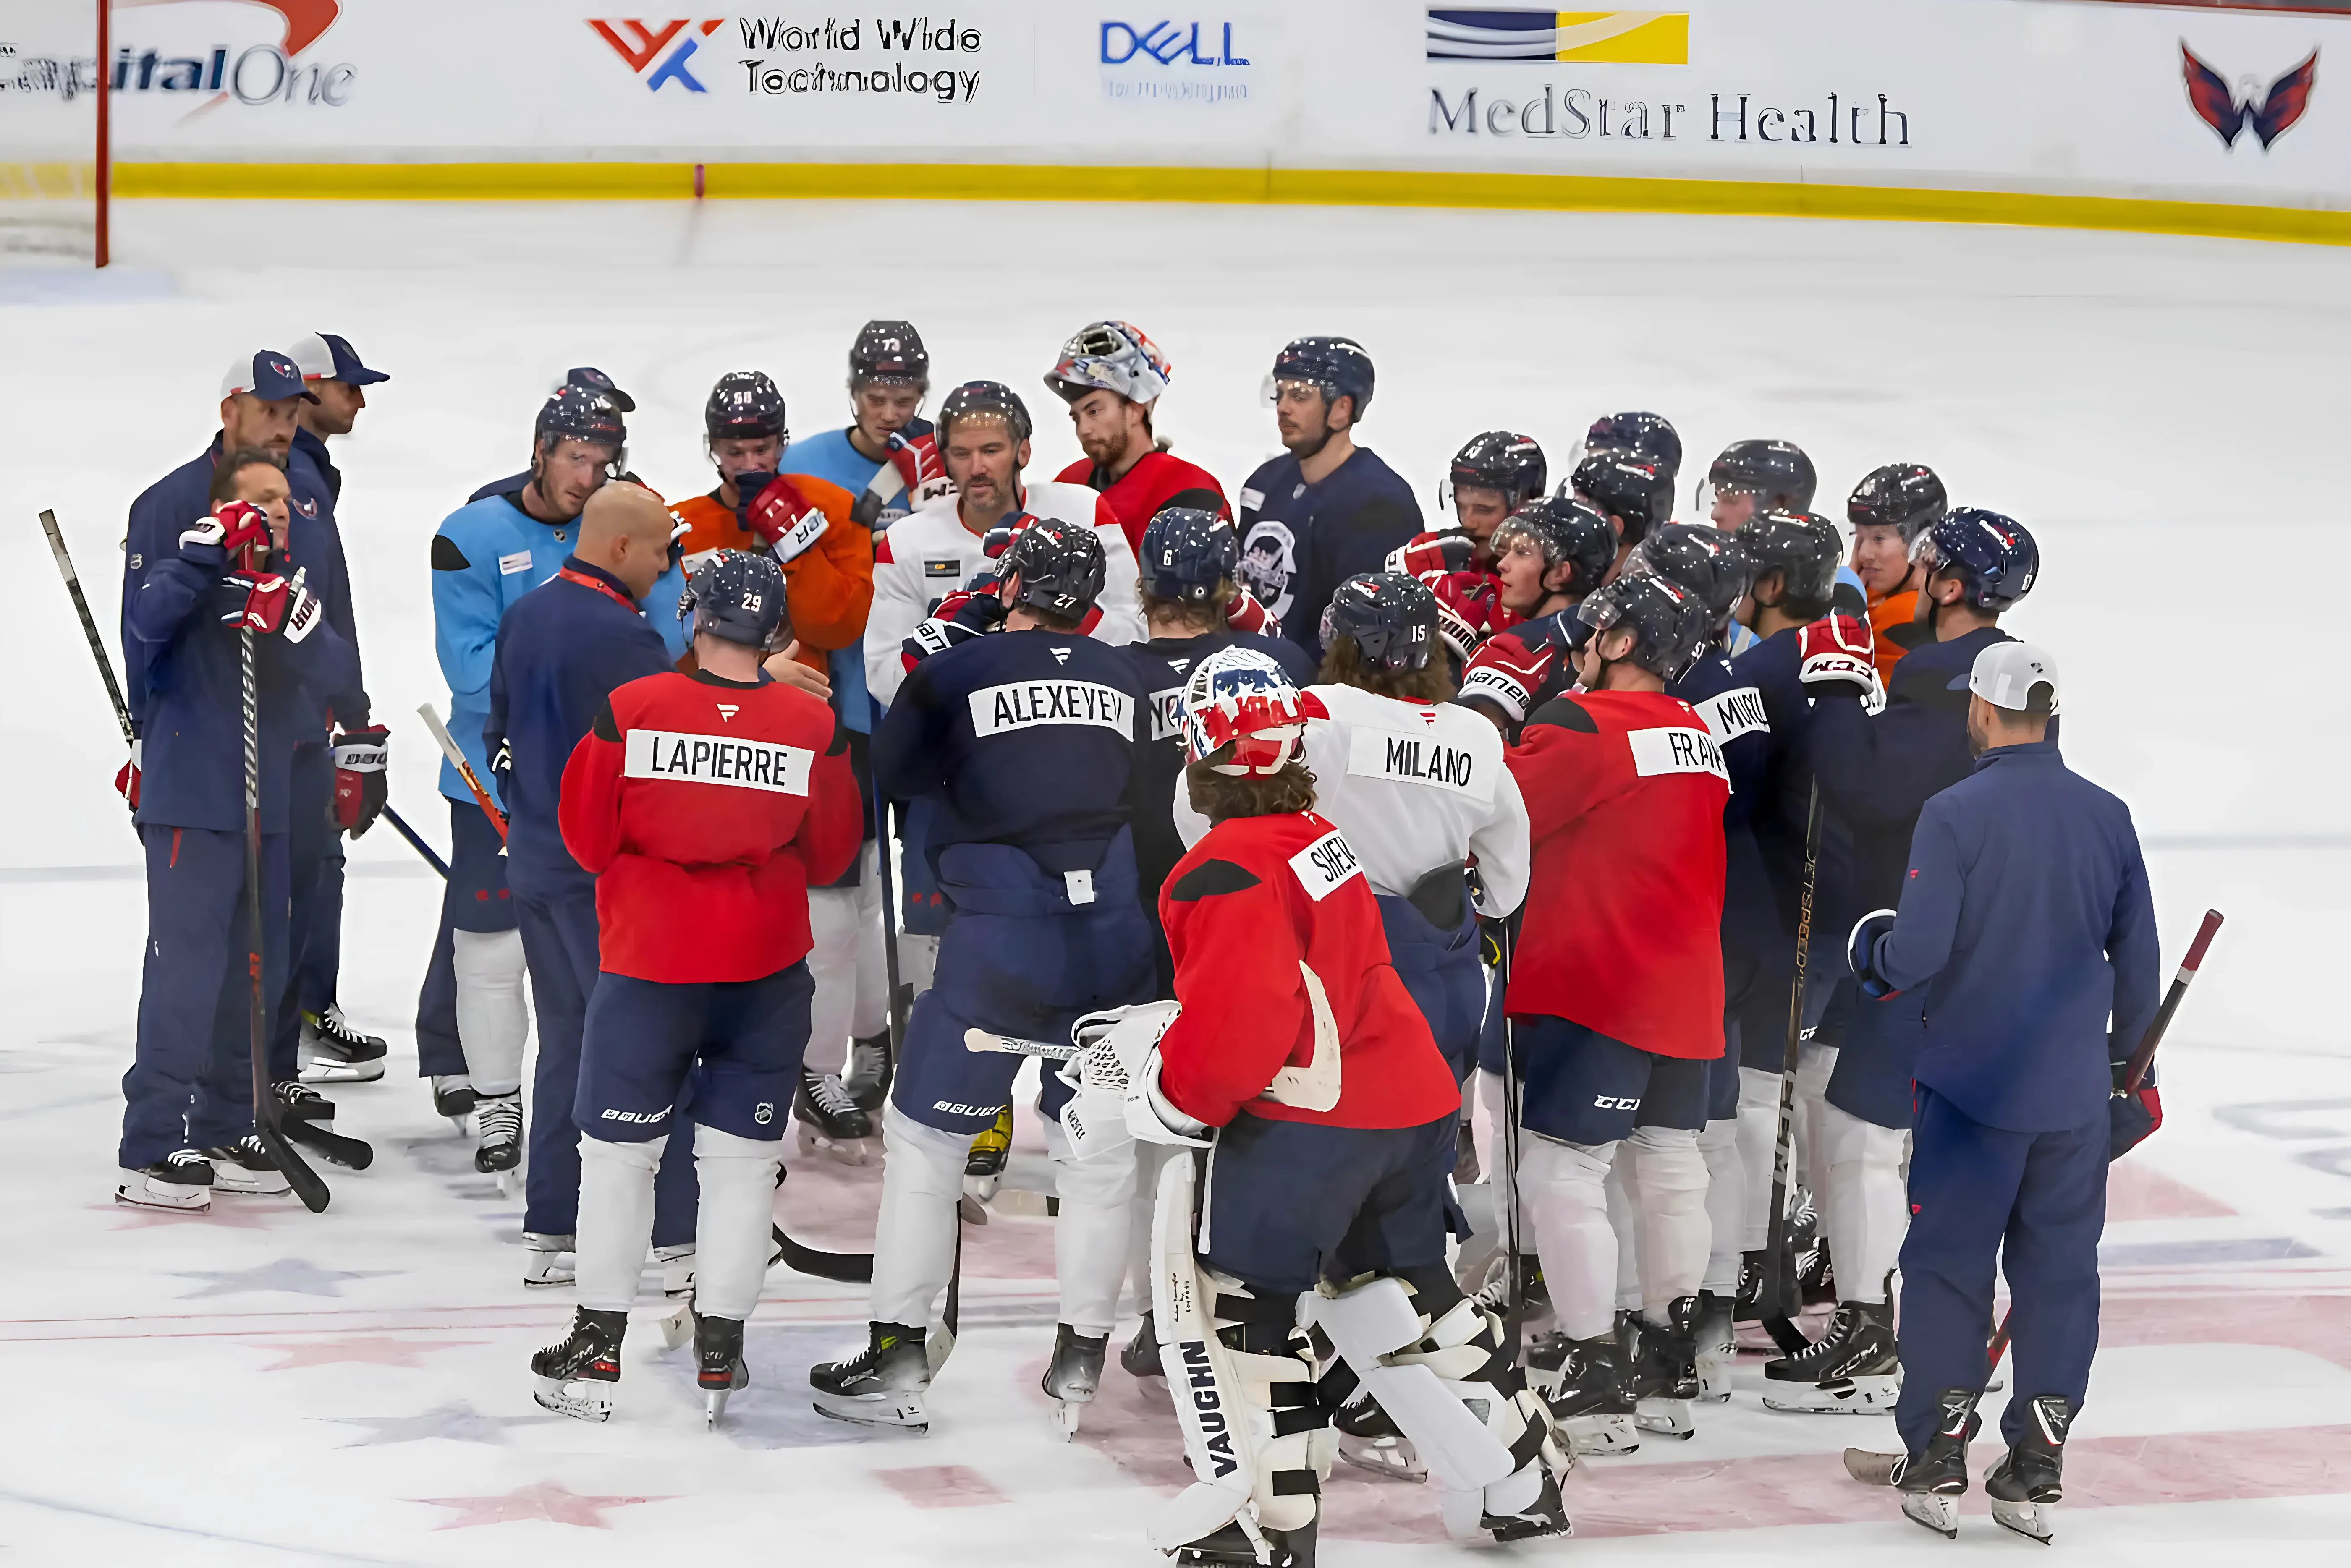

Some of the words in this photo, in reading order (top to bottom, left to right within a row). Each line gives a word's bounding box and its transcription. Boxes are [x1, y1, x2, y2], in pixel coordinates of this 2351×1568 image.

[738, 16, 860, 52] World
[877, 16, 982, 53] Wide
[1101, 20, 1250, 66] DELL
[737, 59, 981, 105] Technology
[1428, 84, 1686, 139] MedStar
[1708, 91, 1912, 147] Health
[741, 593, 762, 612] 29
[1054, 594, 1077, 609] 27
[994, 685, 1121, 729] ALEXEYEV
[652, 737, 787, 787] LAPIERRE
[1386, 737, 1472, 787] MILANO
[1179, 1341, 1238, 1479] VAUGHN
